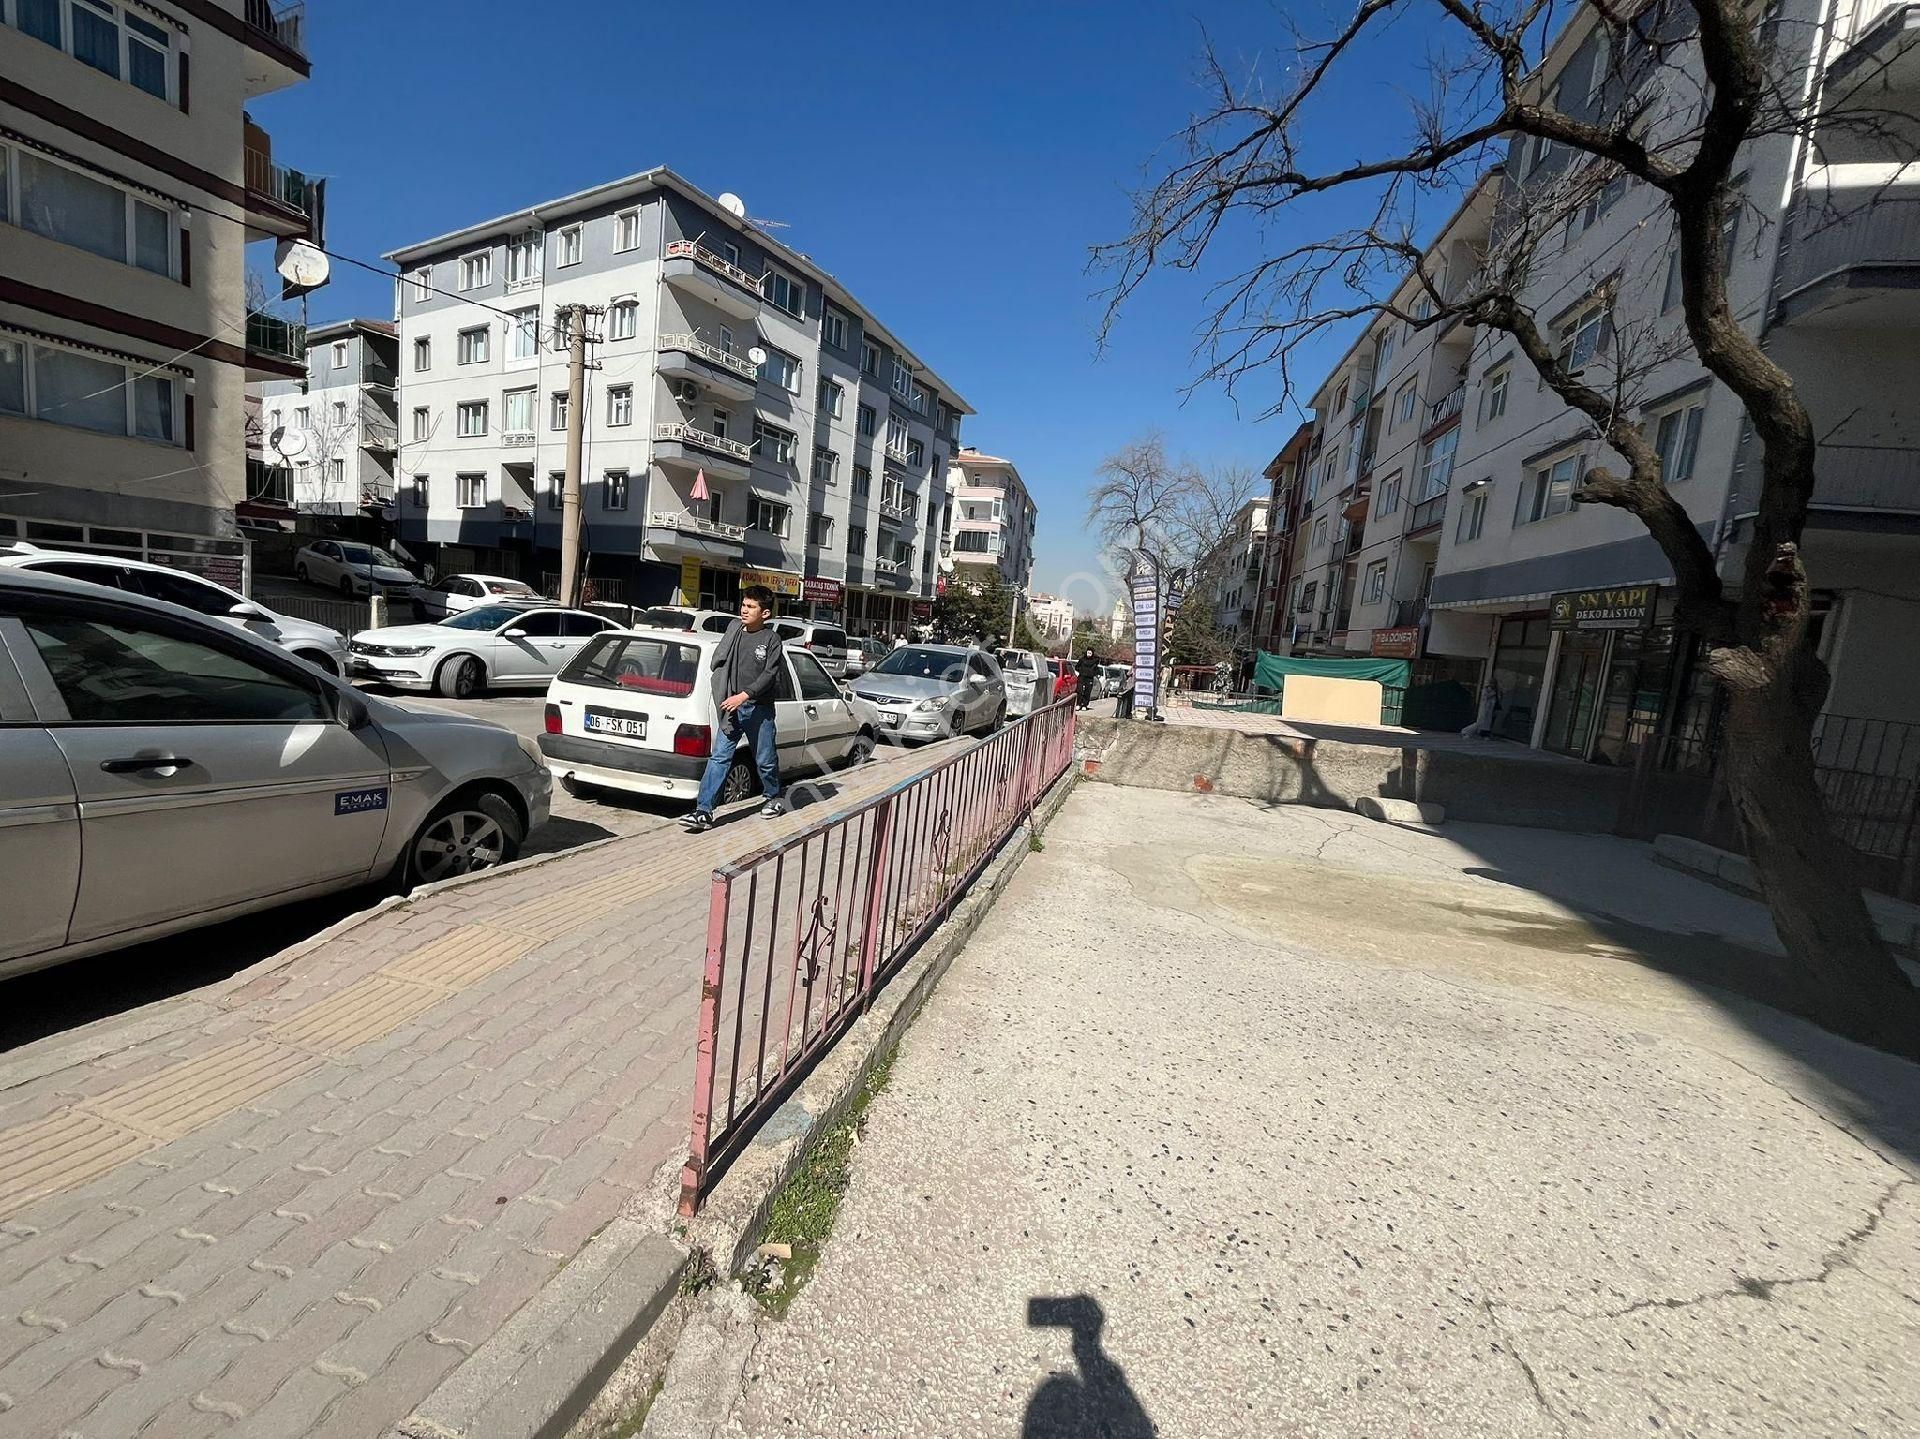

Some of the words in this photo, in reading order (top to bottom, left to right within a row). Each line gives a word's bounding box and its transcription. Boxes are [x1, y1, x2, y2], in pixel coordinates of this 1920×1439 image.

[1579, 593, 1599, 607] SN
[1604, 588, 1648, 607] YAPI
[1576, 608, 1646, 619] DEKORASYON
[590, 715, 601, 728] 06
[626, 721, 643, 735] 051
[340, 793, 382, 805] EMAK
